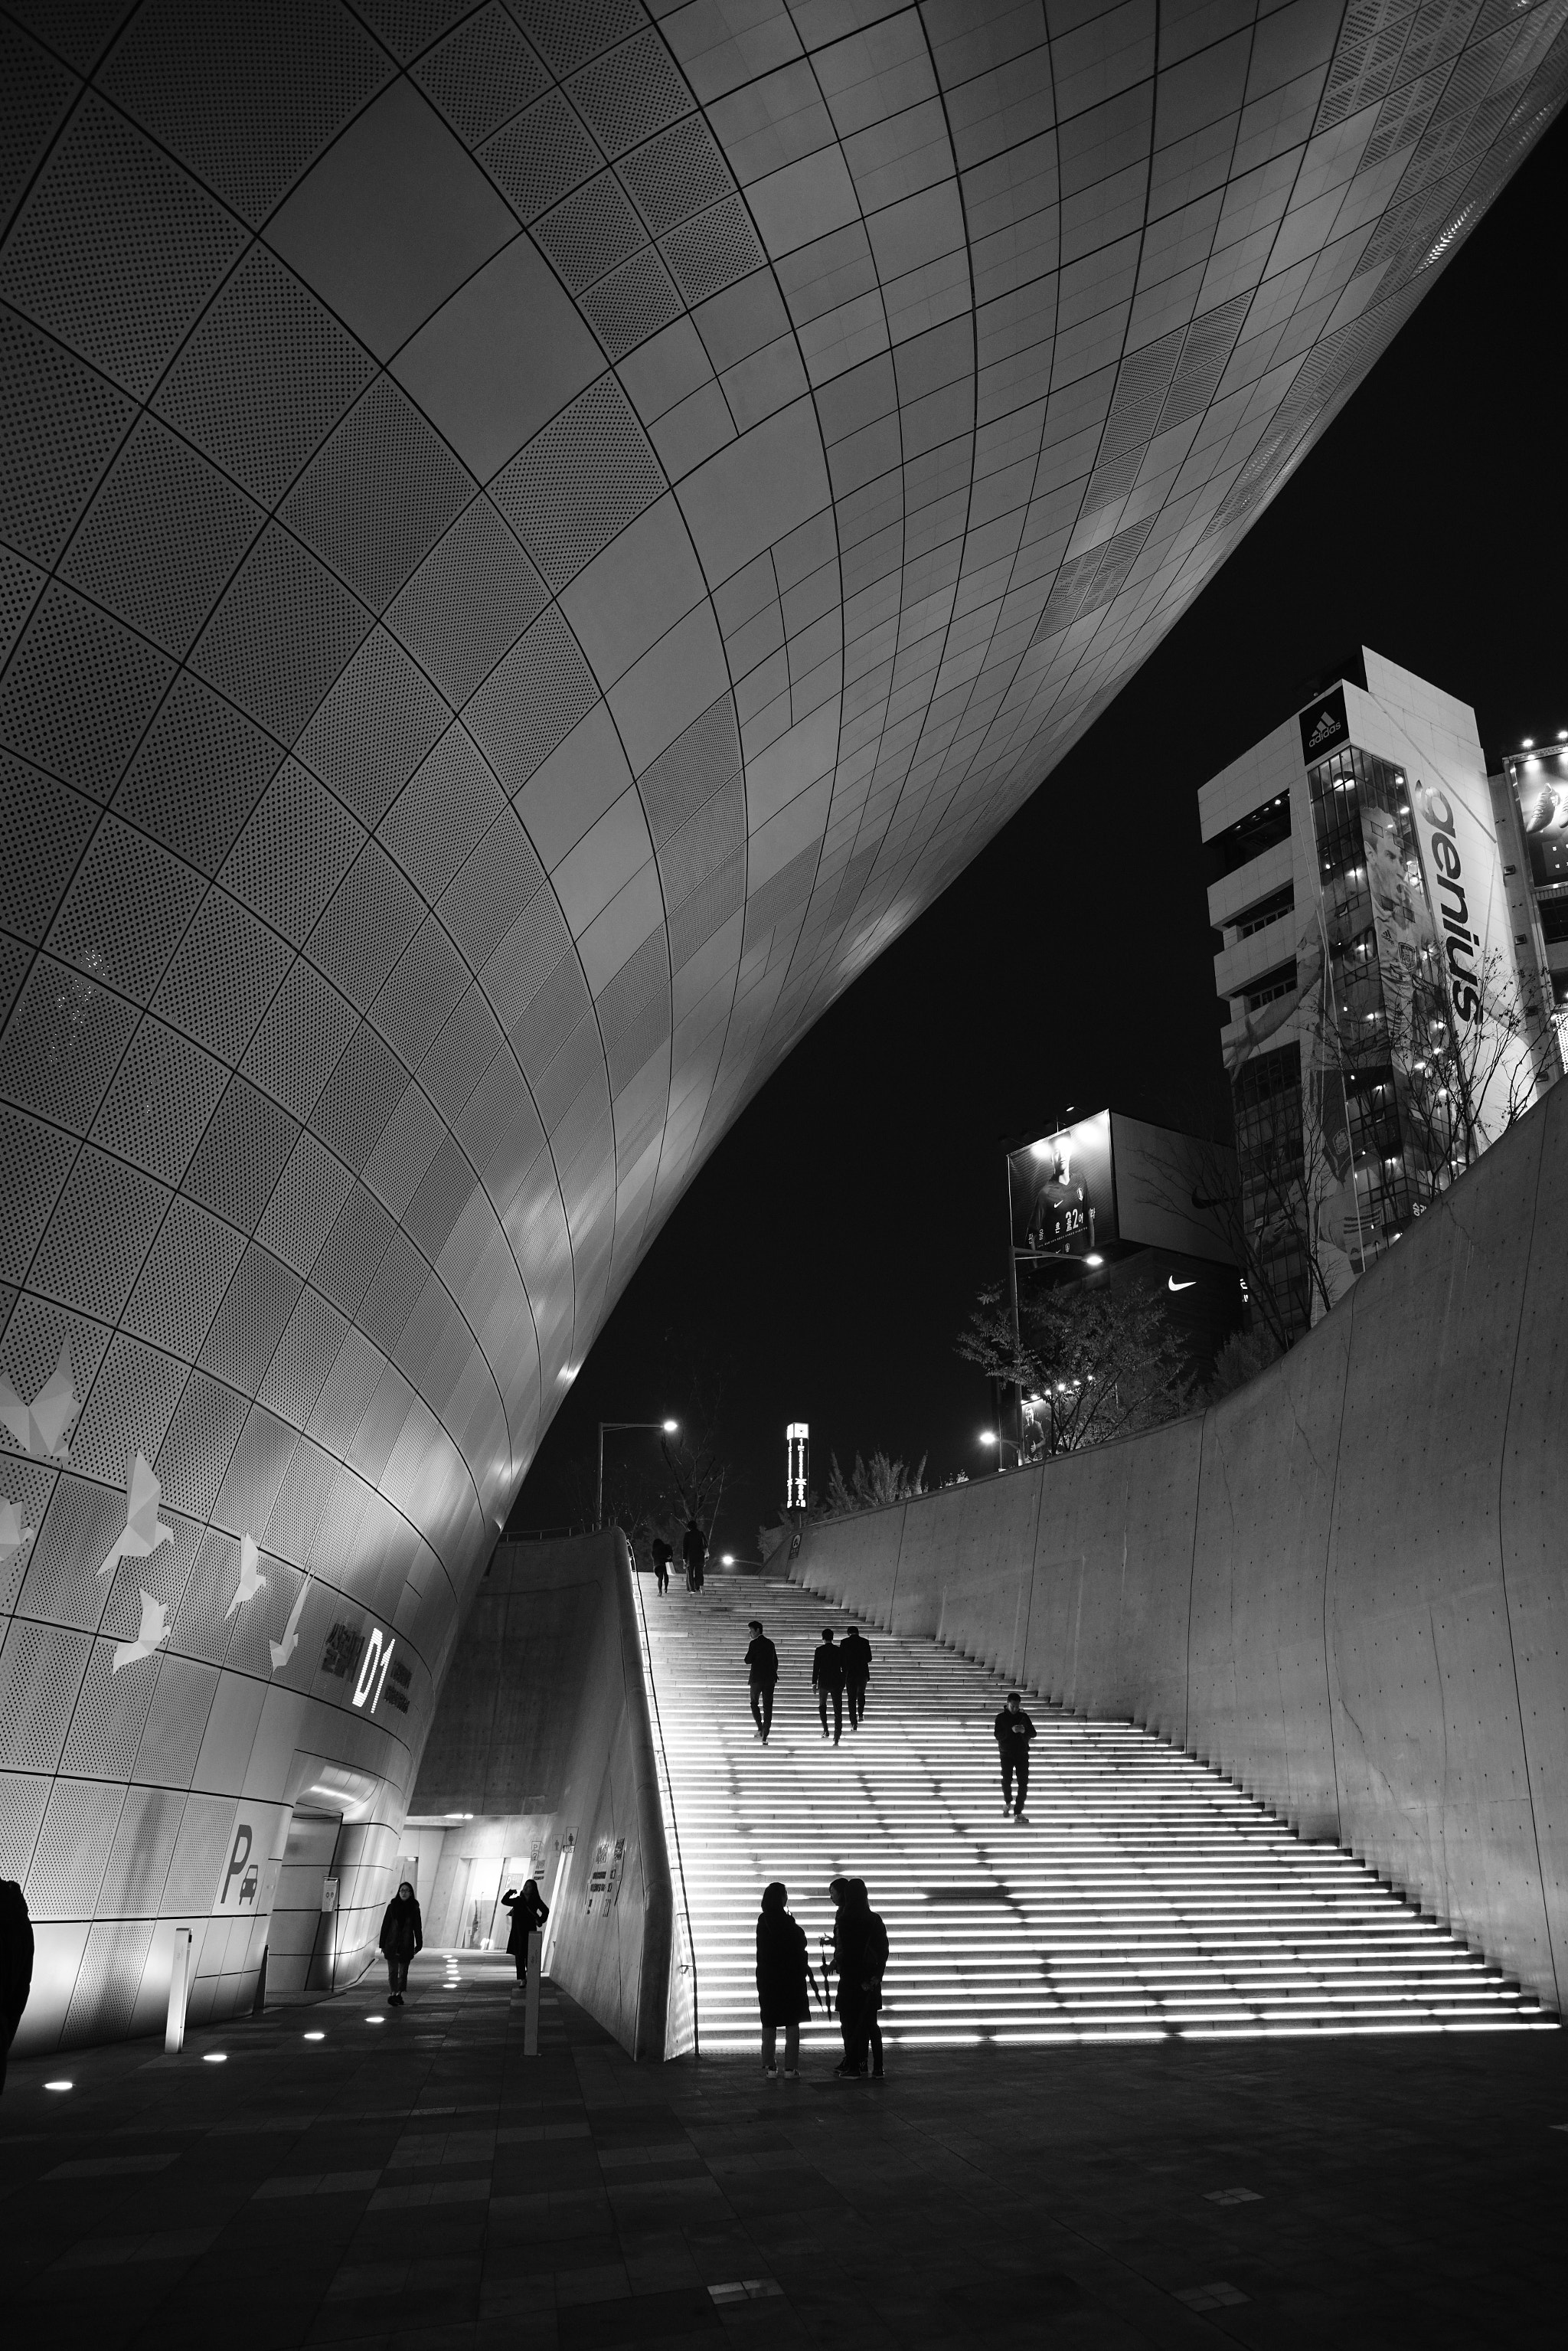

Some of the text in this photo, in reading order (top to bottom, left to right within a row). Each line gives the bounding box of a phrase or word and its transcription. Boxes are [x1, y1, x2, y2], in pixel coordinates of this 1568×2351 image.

[1308, 721, 1341, 747] adidas
[1415, 779, 1484, 1026] genius
[220, 1824, 253, 1904] P
